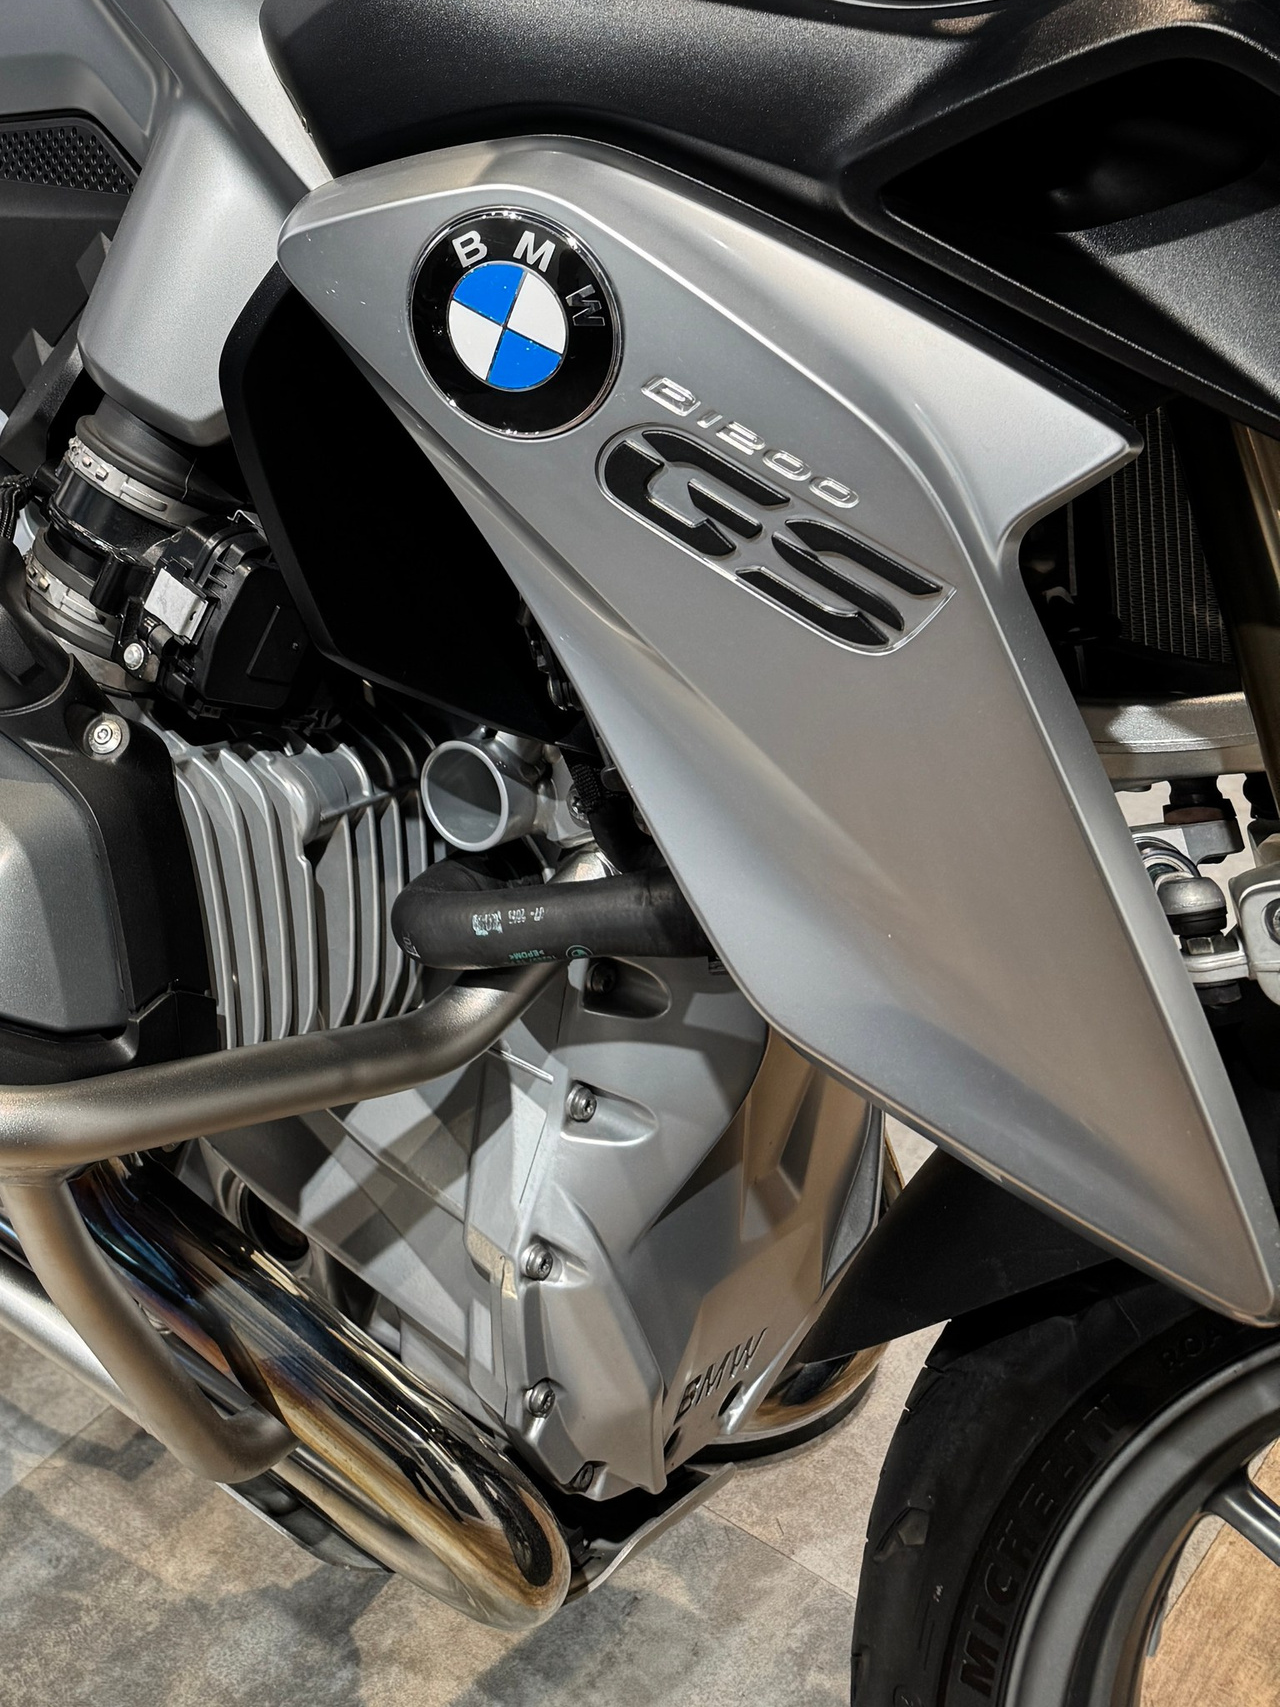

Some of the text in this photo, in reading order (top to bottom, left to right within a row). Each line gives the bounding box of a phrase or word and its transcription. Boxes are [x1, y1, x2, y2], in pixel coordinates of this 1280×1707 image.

[452, 230, 605, 328] BMW
[640, 375, 860, 509] R1200
[599, 425, 949, 650] GS
[674, 1327, 768, 1423] BMW
[959, 1394, 1128, 1698] MICHELIN
